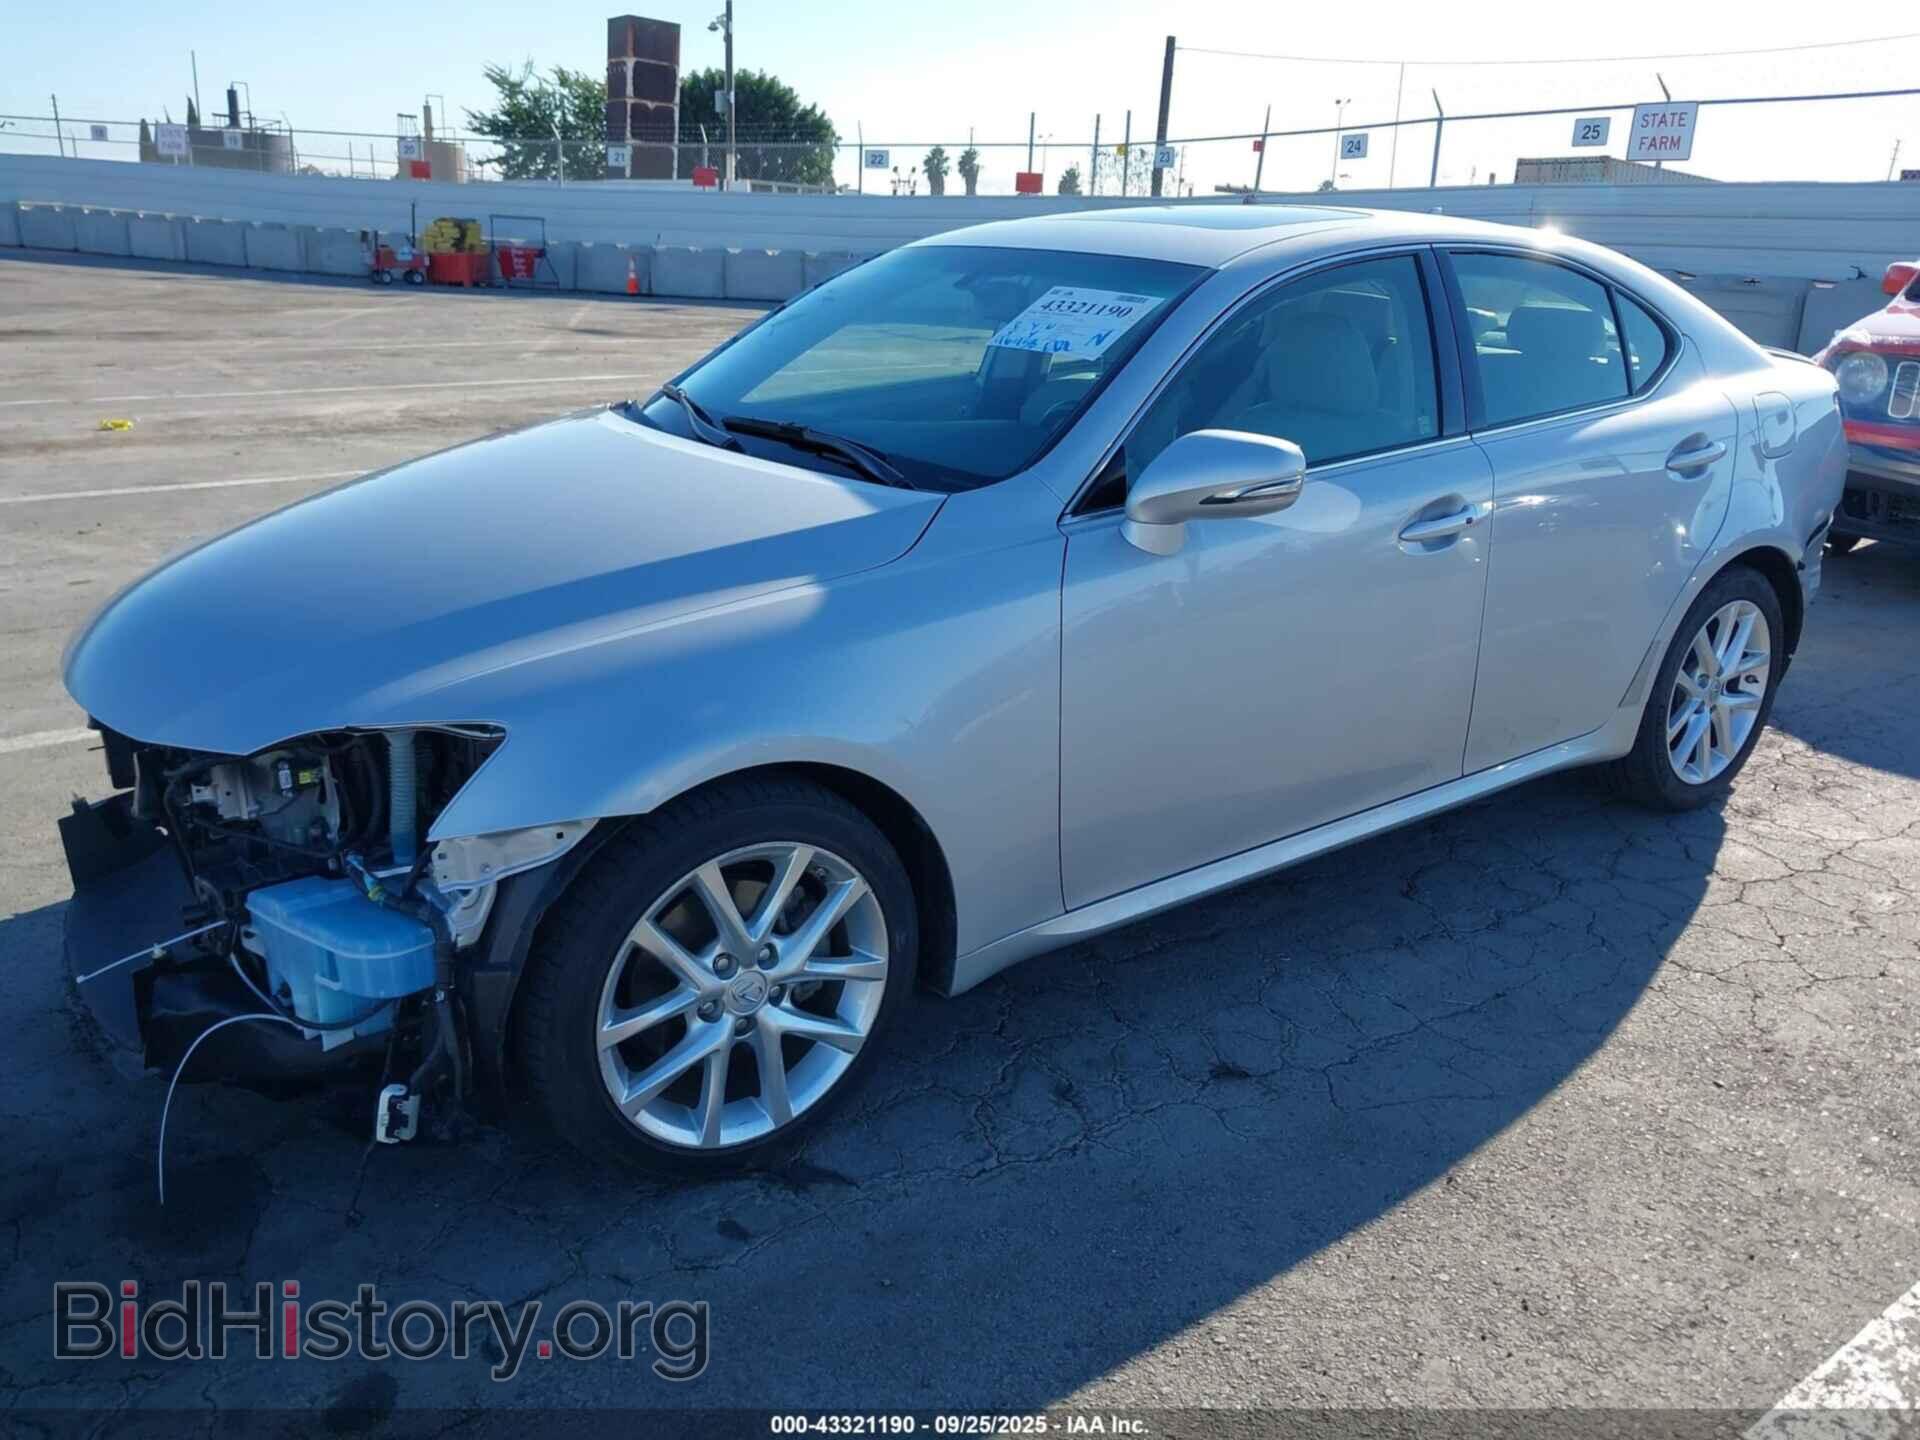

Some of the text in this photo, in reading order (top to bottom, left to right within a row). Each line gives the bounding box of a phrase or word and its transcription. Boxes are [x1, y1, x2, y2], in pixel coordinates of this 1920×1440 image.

[1640, 111, 1688, 128] STATE
[1581, 124, 1601, 140] 25
[404, 144, 416, 155] 20
[1346, 140, 1362, 153] 24
[1638, 135, 1682, 152] FARM
[613, 151, 625, 162] 21
[870, 154, 884, 165] 22
[1159, 151, 1170, 163] 23
[1040, 300, 1134, 318] 43321190
